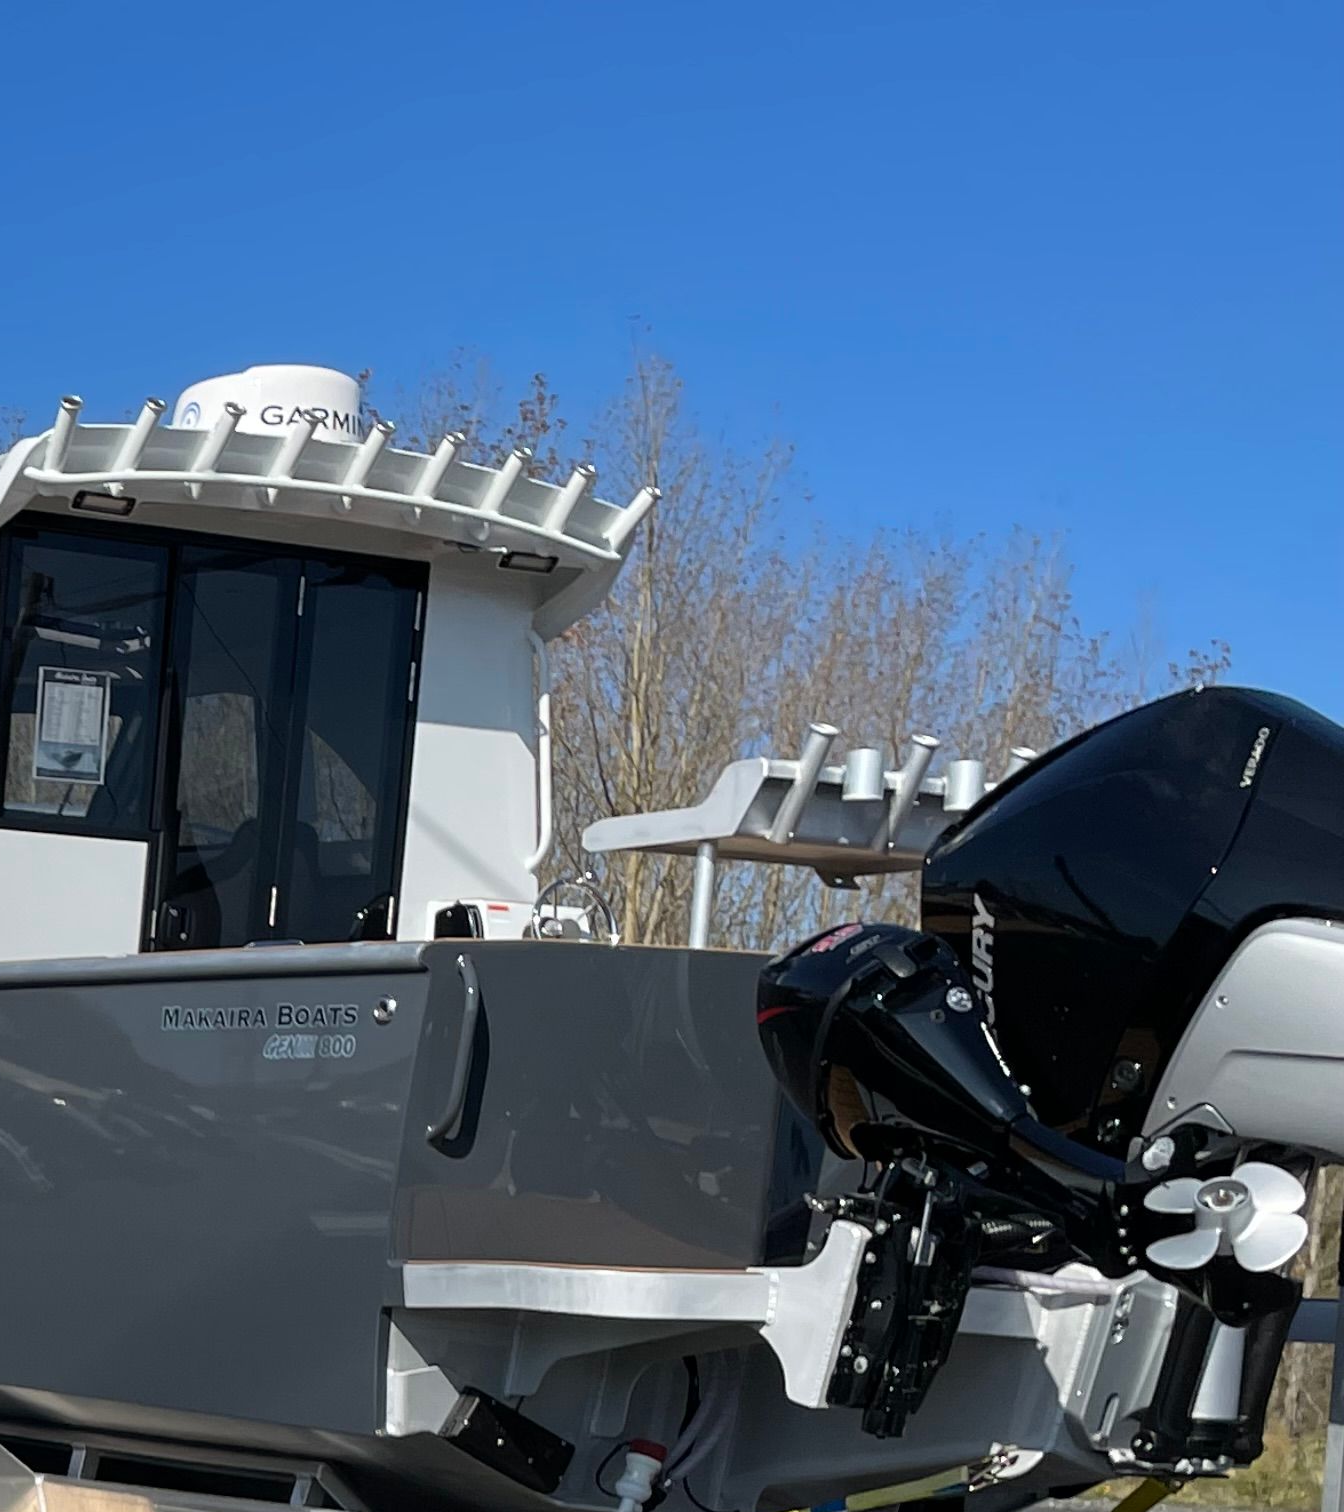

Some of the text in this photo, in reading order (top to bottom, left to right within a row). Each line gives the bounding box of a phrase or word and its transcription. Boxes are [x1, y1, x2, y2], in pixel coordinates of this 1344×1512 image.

[1239, 727, 1270, 788] VERADO
[277, 1003, 358, 1029] BOATS
[318, 1034, 357, 1058] 800
